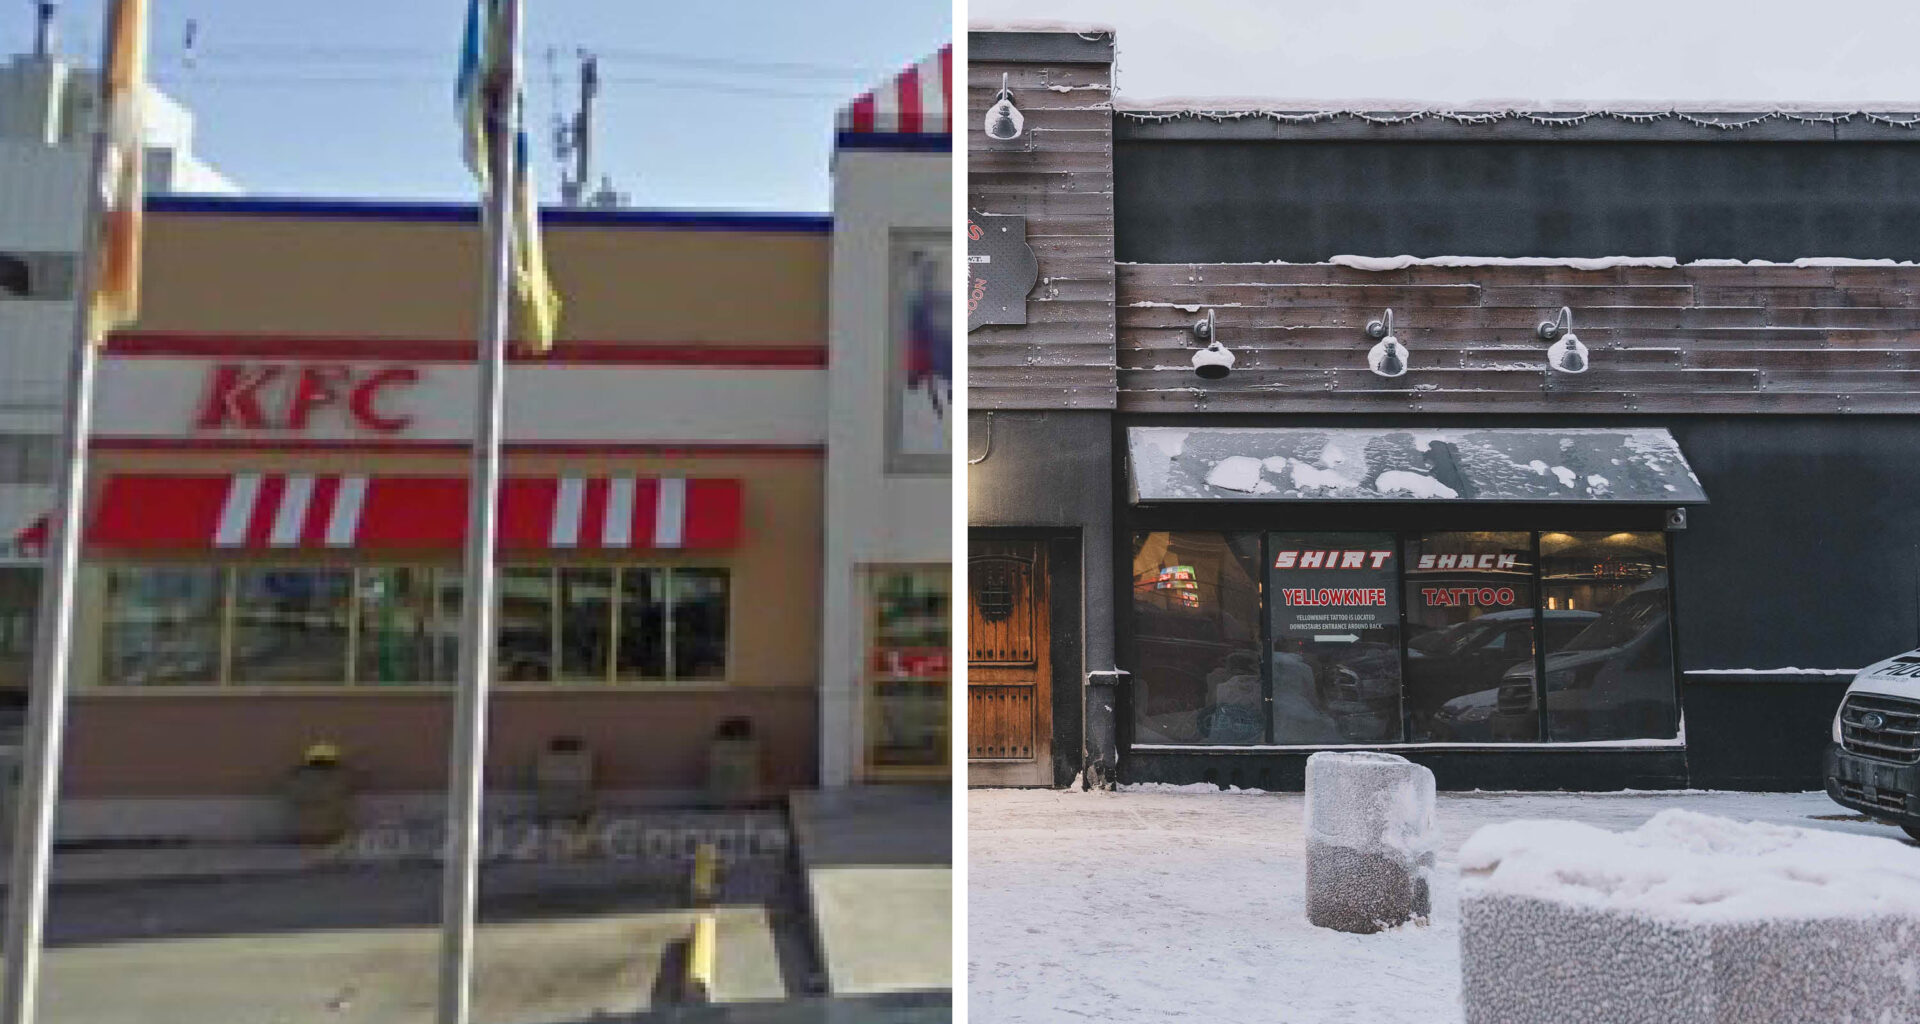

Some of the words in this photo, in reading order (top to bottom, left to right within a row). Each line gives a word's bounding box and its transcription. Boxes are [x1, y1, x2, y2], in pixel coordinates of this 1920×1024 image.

[197, 363, 420, 433] KFC
[1274, 550, 1393, 569] SHIRT
[1416, 553, 1518, 570] SHACK
[1282, 588, 1387, 606] YELLOWKNIFE
[1421, 587, 1515, 606] TATTOO
